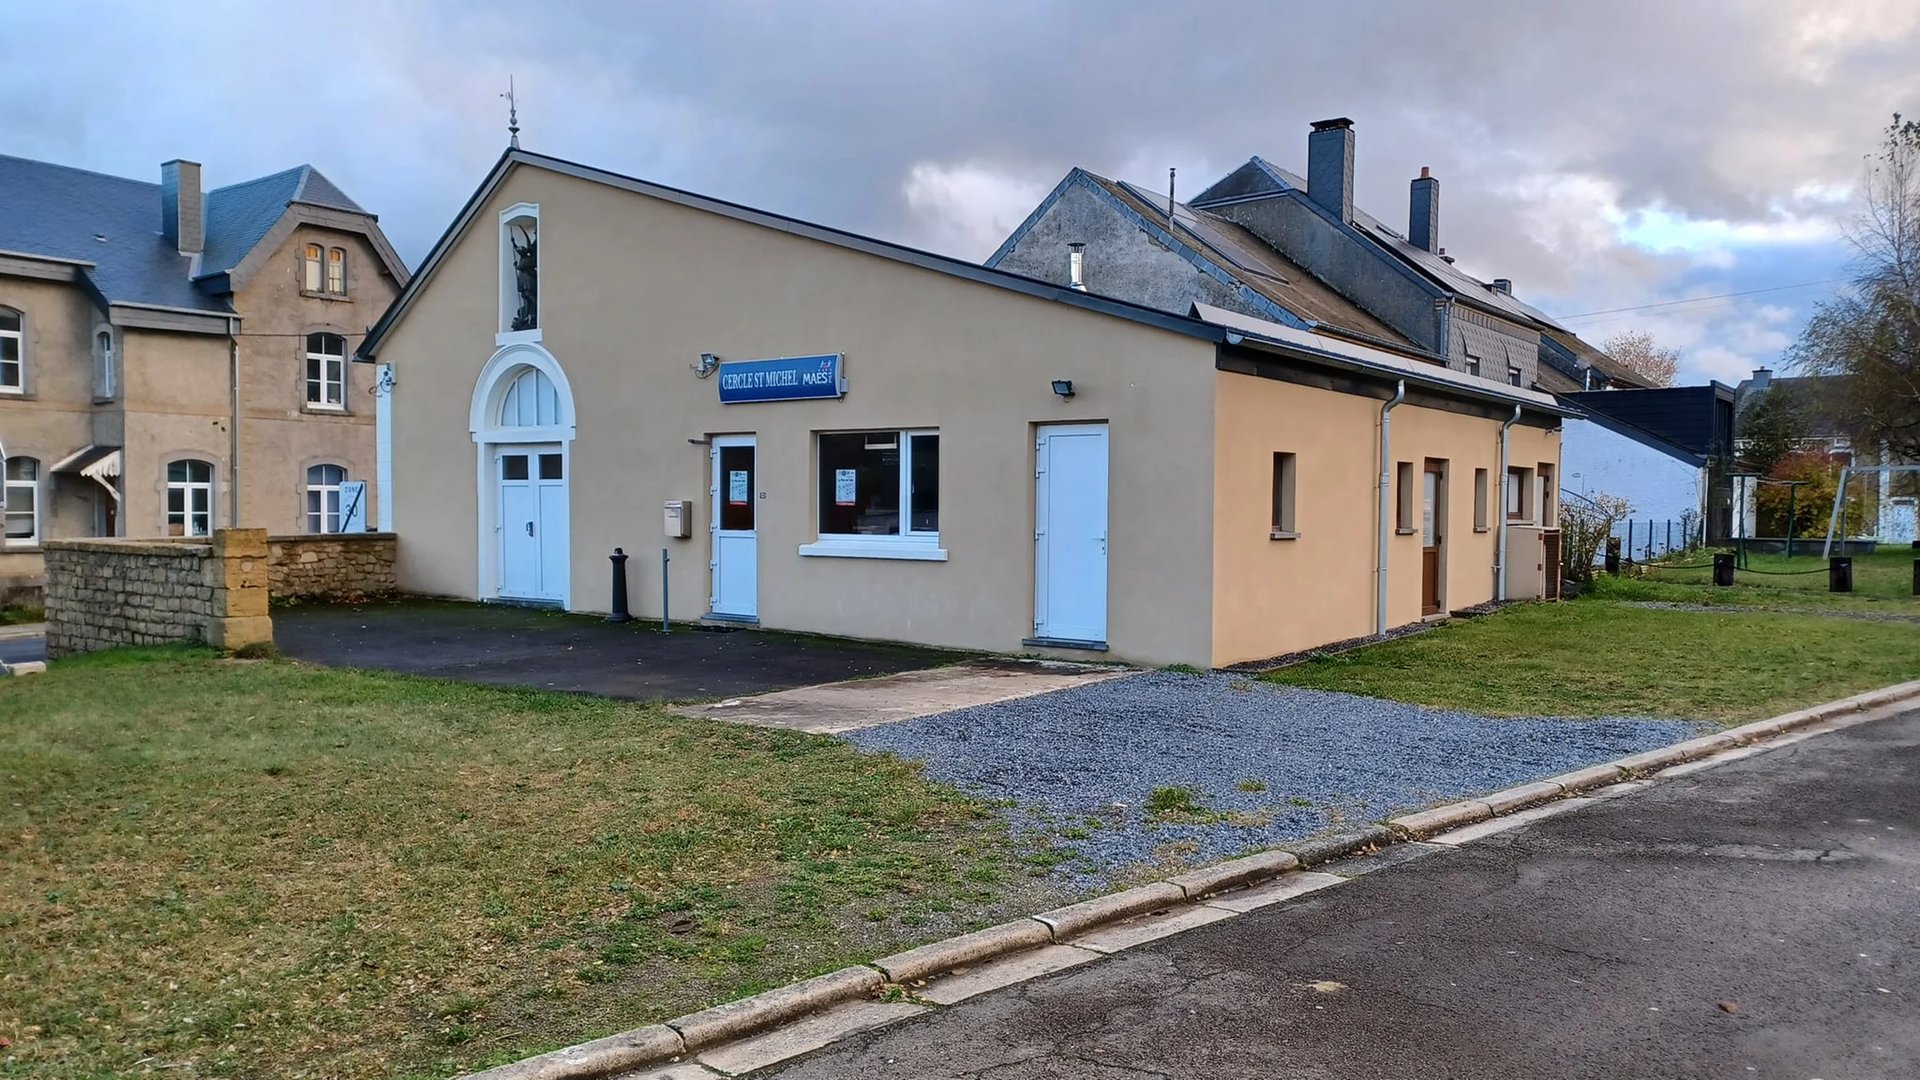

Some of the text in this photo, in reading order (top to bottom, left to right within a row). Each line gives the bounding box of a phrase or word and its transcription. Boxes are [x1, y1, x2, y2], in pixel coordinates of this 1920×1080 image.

[722, 370, 798, 390] CERCLE ST MICHEL
[802, 372, 828, 386] MAES
[345, 504, 359, 518] 30
